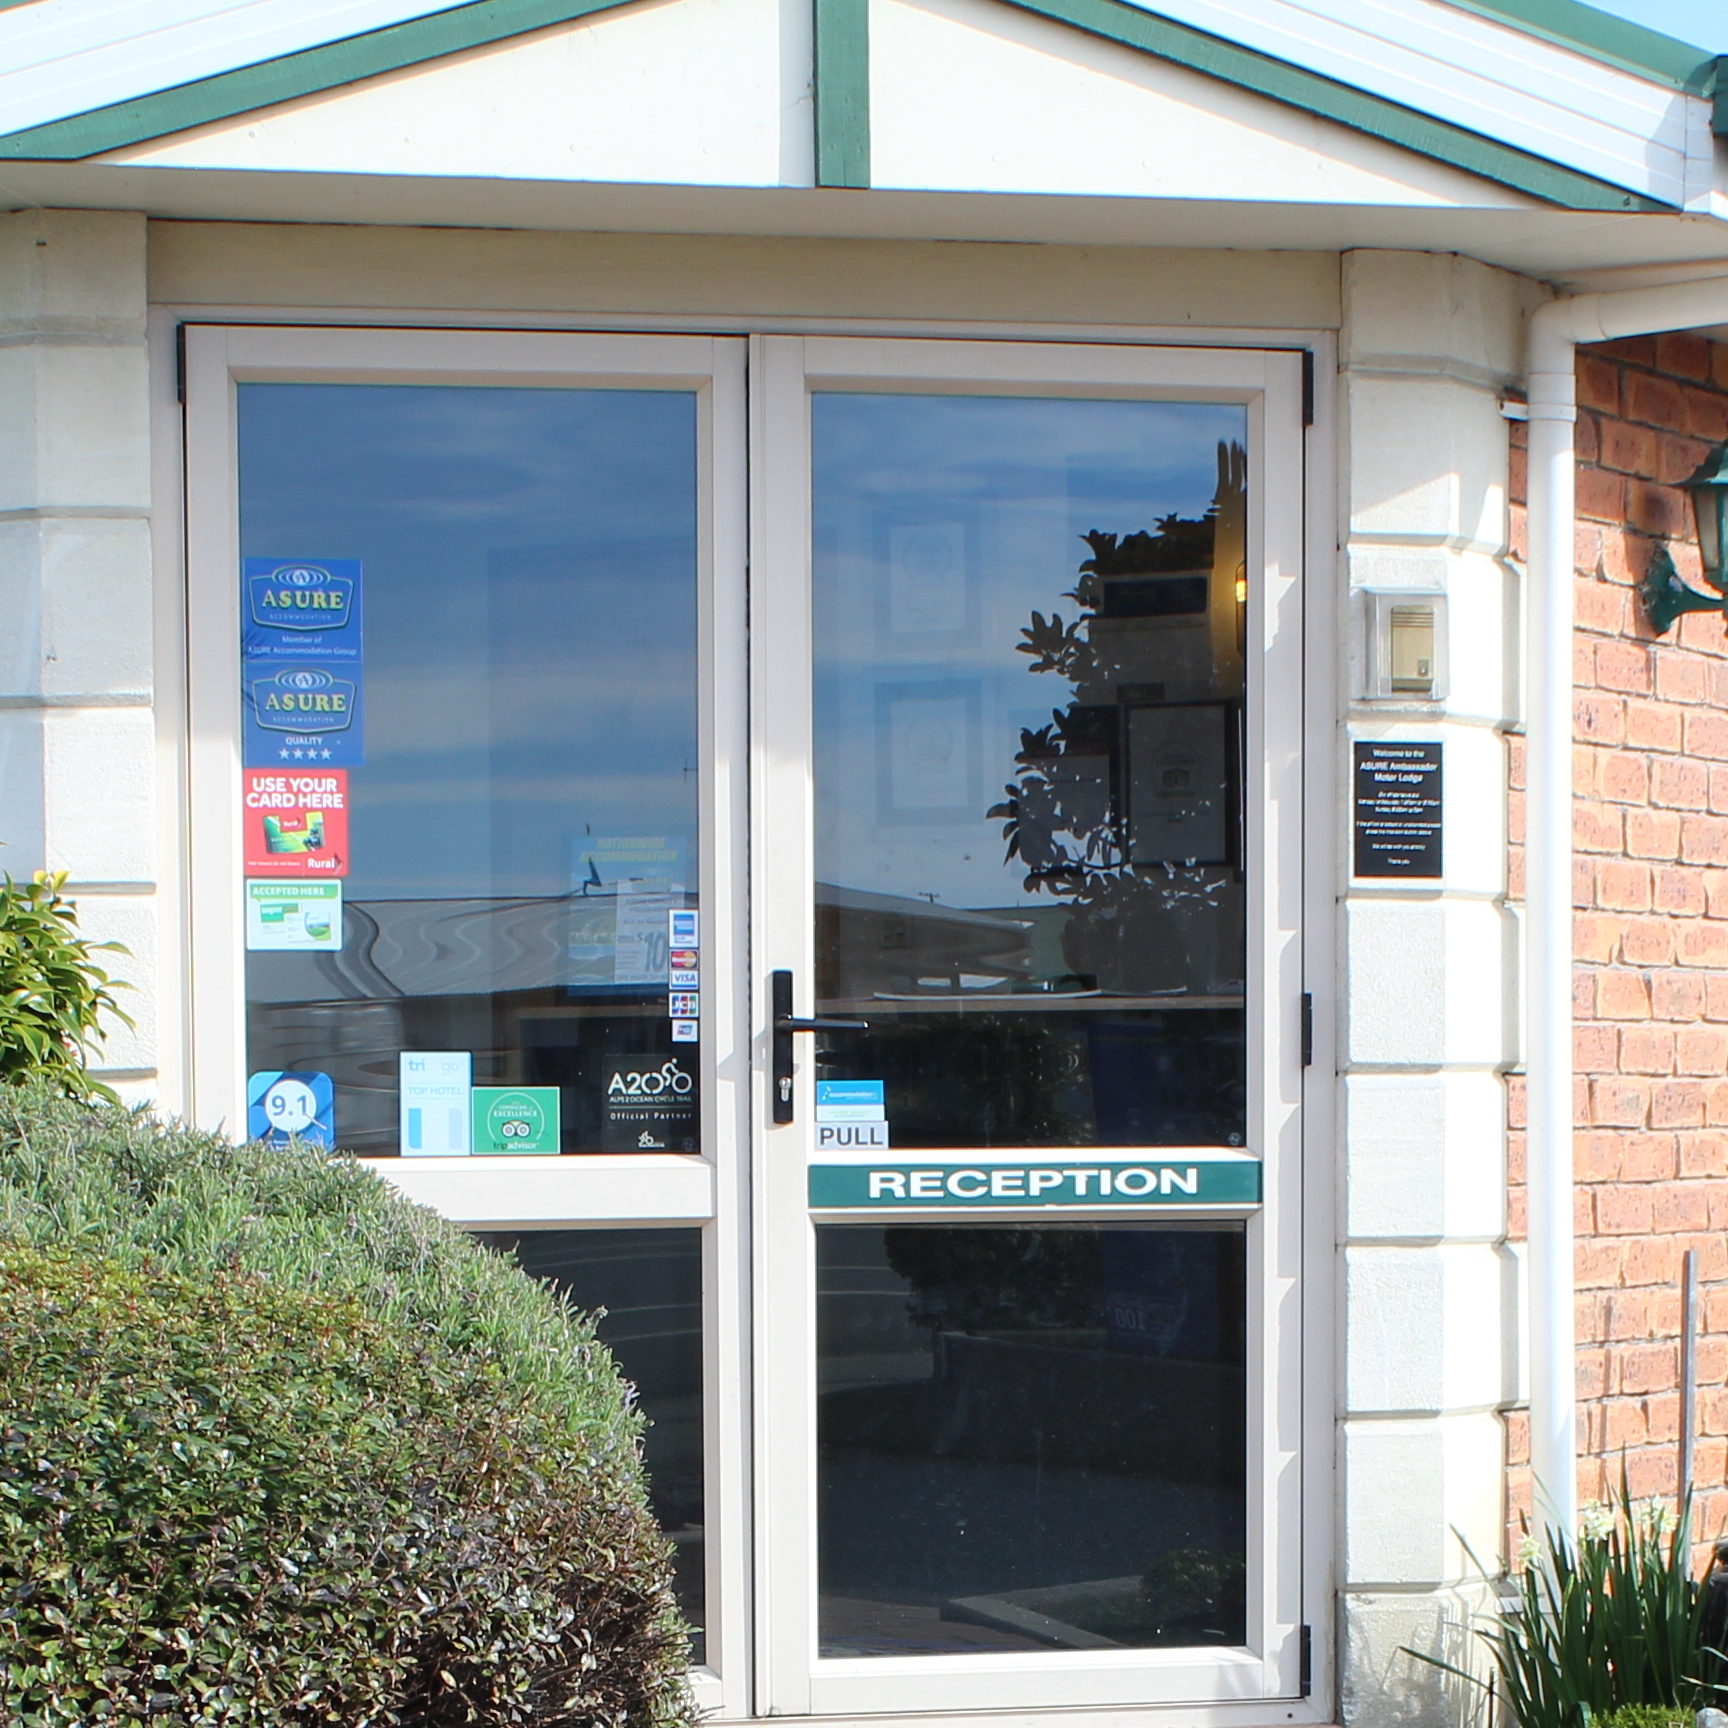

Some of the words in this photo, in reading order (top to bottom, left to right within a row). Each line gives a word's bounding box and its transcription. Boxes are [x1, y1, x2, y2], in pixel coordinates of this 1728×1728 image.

[262, 589, 344, 609] ASURE
[273, 647, 332, 655] Accommodation
[334, 648, 357, 657] Group
[265, 692, 346, 712] ASURE
[285, 737, 323, 745] QUALITY
[252, 777, 287, 792] USE
[289, 777, 337, 792] YOUR
[246, 793, 296, 808] CARD
[298, 793, 344, 808] HERE
[307, 857, 335, 868] Rural
[253, 886, 299, 896] ACCEPTED
[300, 886, 325, 896] HERE
[674, 973, 697, 983] VISA
[408, 1086, 428, 1096] TOP
[430, 1086, 462, 1096] HOTEL
[271, 1094, 307, 1116] 9.1
[493, 1110, 538, 1118] EXCELLENCE
[610, 1112, 649, 1120] Official
[654, 1111, 692, 1120] Partner
[820, 1126, 884, 1146] PULL
[868, 1167, 1199, 1199] RECEPTION
